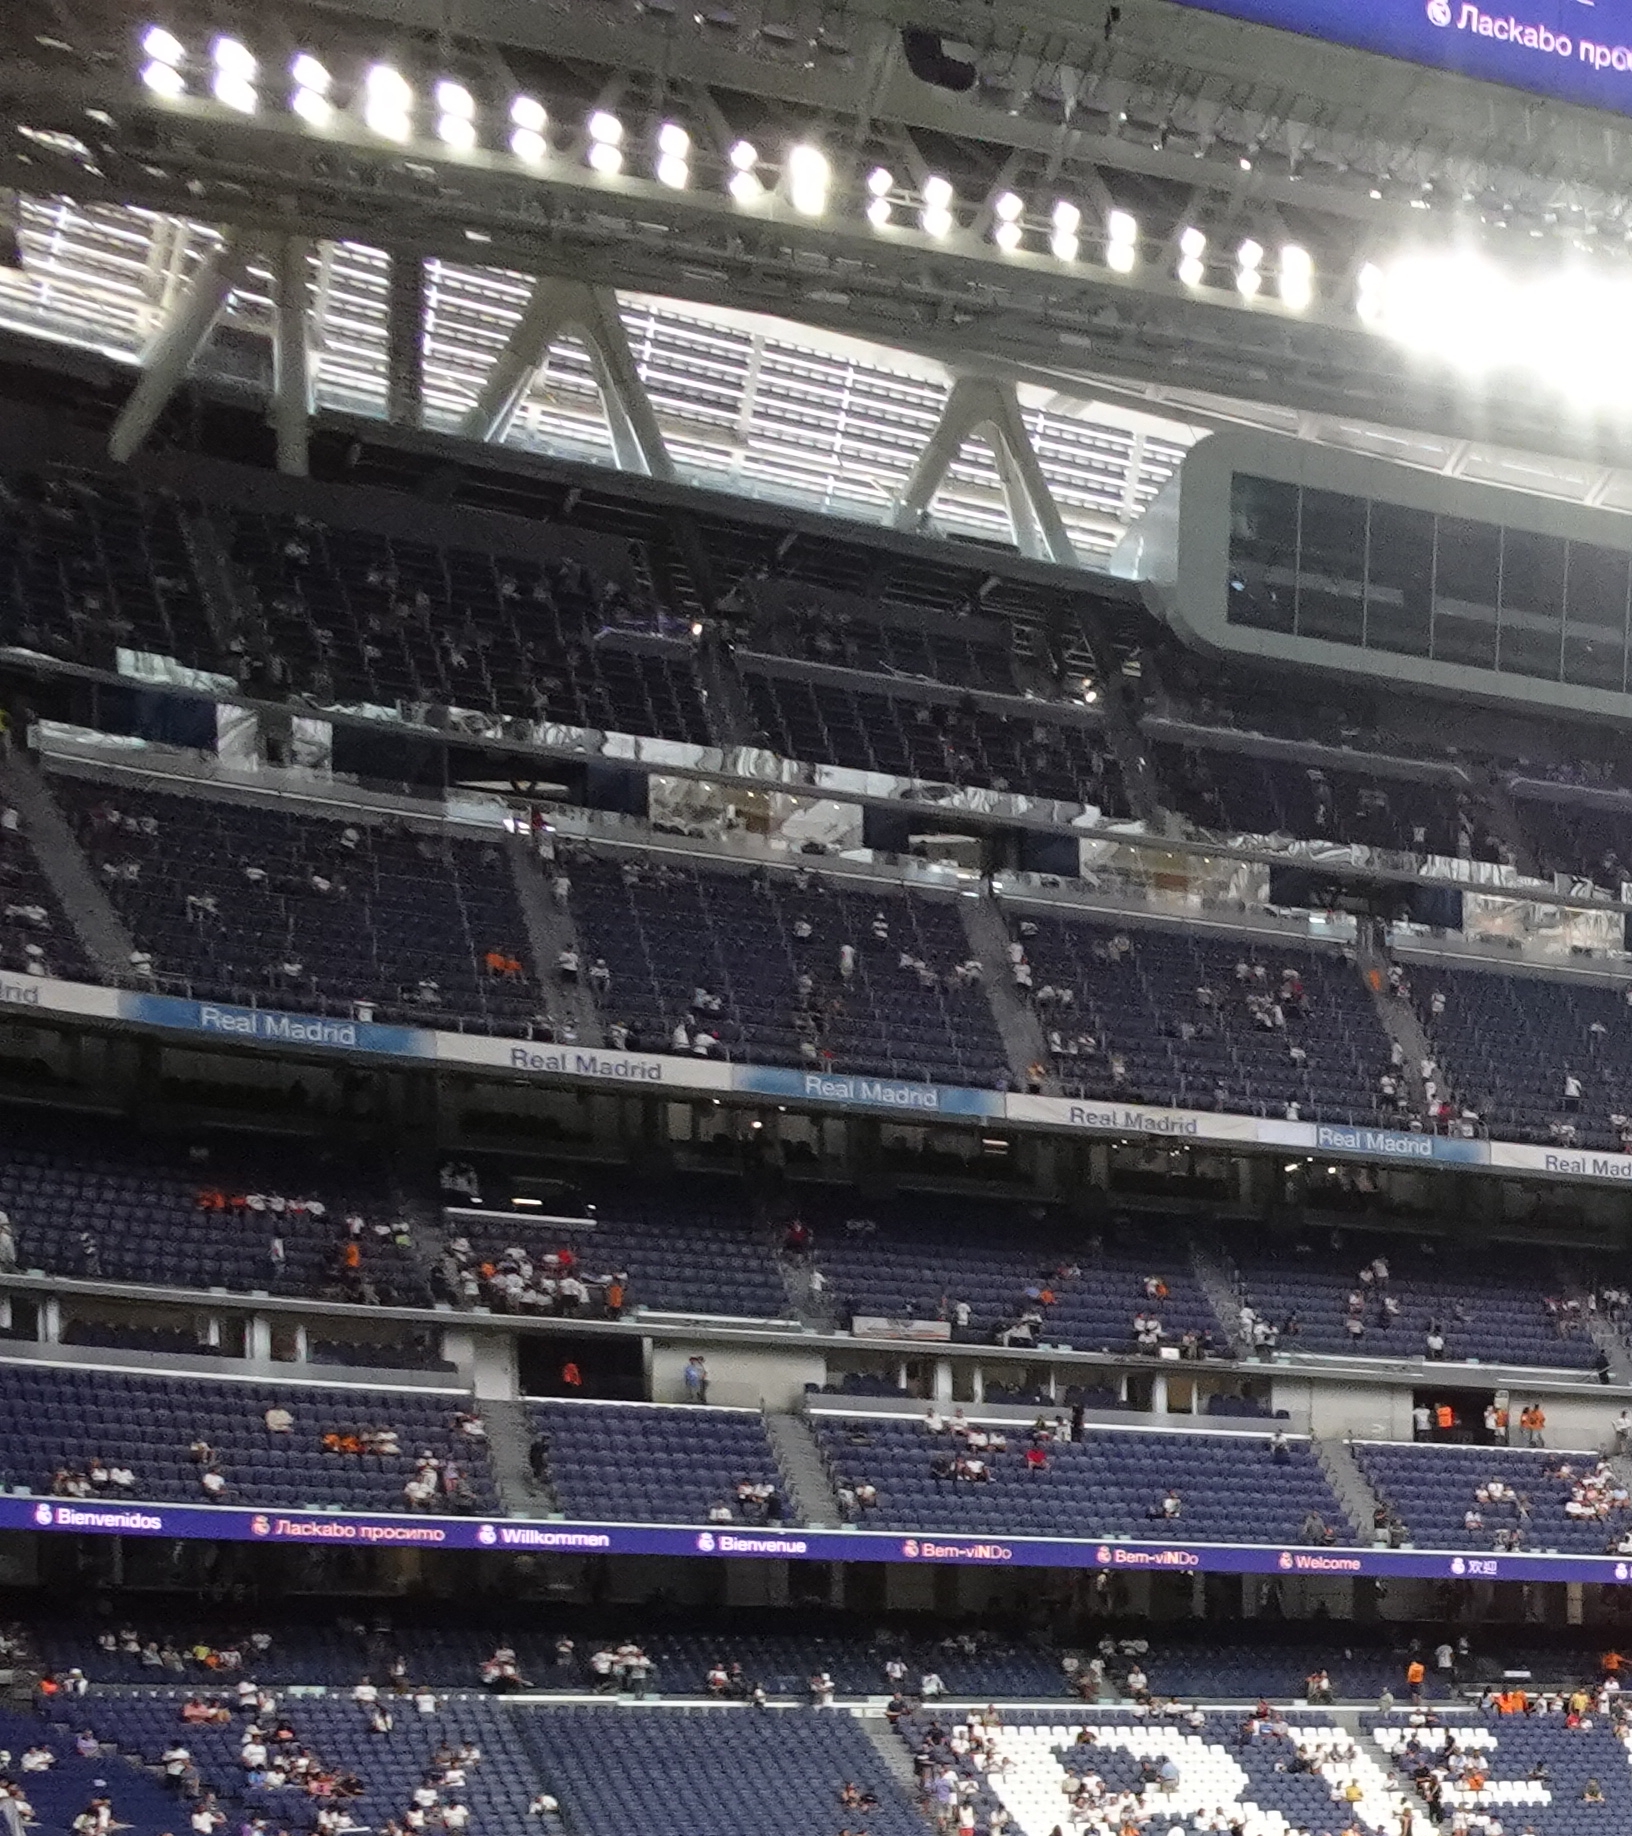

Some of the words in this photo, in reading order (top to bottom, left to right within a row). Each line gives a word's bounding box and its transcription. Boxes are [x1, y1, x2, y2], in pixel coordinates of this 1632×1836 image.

[201, 1006, 256, 1033] Real
[265, 1017, 355, 1046] Madrid
[511, 1049, 564, 1072] Real
[575, 1054, 661, 1081] Madrid
[805, 1074, 854, 1098] Real
[862, 1081, 938, 1106] Madrid
[1070, 1106, 1117, 1126] Real
[1124, 1111, 1197, 1135] Madrid
[1318, 1127, 1361, 1148] Real
[1367, 1133, 1432, 1156] Madrid
[1544, 1154, 1588, 1176] Real
[55, 1507, 163, 1530] Bienvenidos
[502, 1529, 610, 1547] Willkommen
[720, 1536, 807, 1554] Bienvenue
[1296, 1555, 1361, 1571] Welcome
